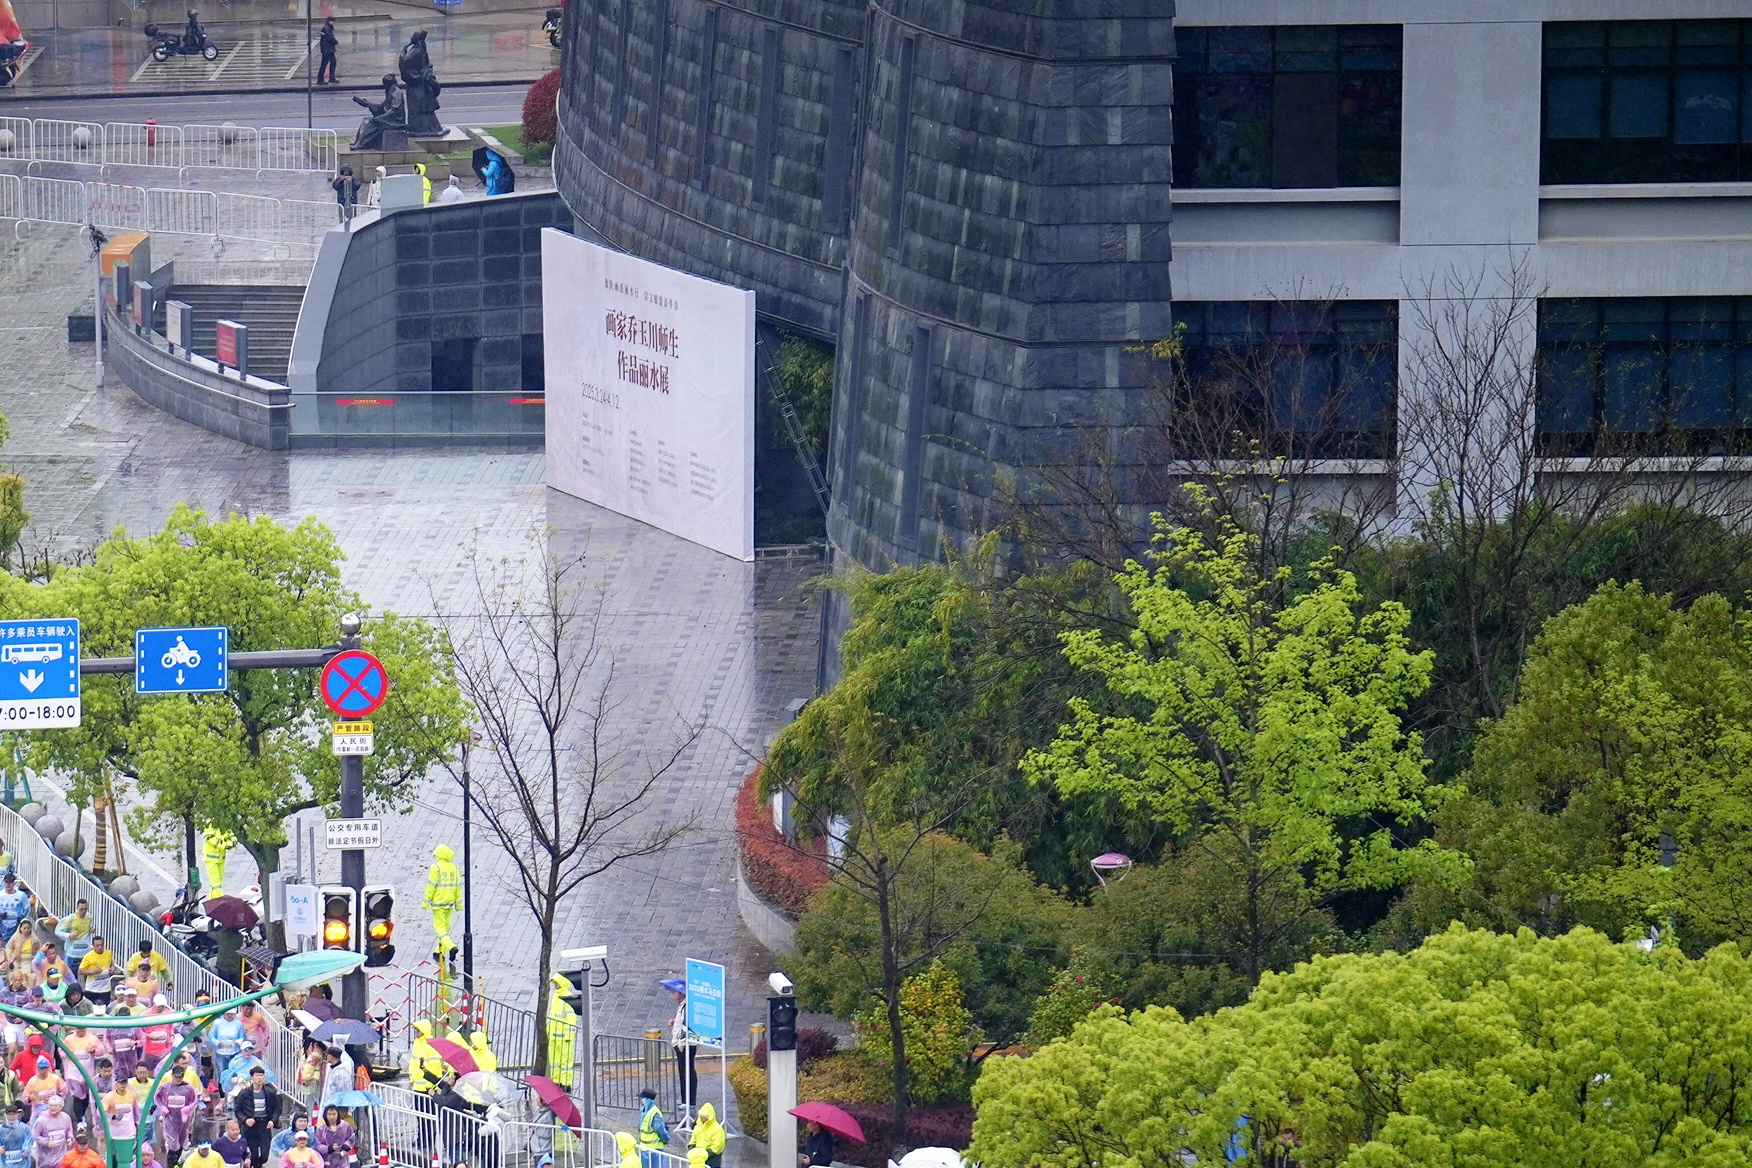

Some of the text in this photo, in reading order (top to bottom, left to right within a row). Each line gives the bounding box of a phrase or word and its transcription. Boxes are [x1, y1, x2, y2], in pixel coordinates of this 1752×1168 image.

[605, 307, 679, 359] 画家乔玉川师生
[617, 349, 669, 395] 作品丽水展
[340, 737, 367, 745] 人民街
[328, 823, 379, 832] 公交专用车道
[328, 837, 379, 845] 除法定节假日外
